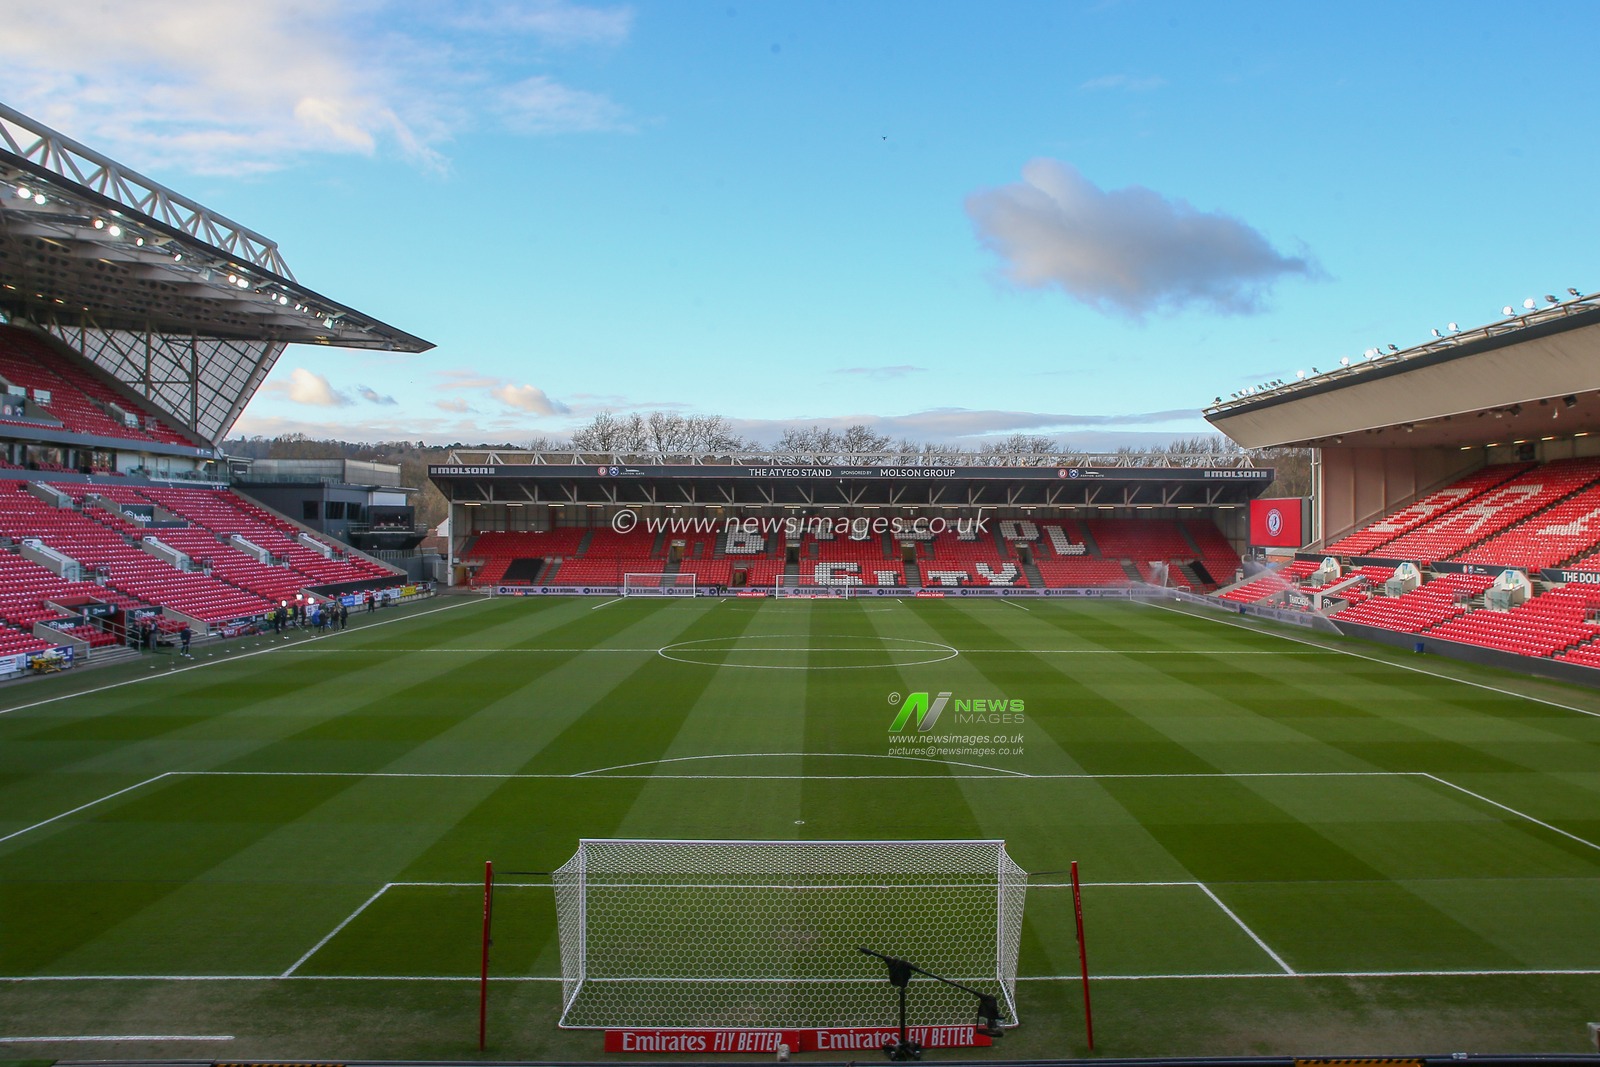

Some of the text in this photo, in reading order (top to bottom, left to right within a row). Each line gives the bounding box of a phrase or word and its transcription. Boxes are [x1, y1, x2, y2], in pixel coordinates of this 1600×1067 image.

[749, 468, 767, 477] THE
[768, 468, 800, 477] ATYEO
[801, 468, 832, 477] STAND
[880, 468, 921, 477] MOLSON
[923, 468, 956, 477] GROUP
[1562, 571, 1578, 582] THE
[622, 1031, 783, 1052] Emirates FLY BETTER
[816, 1026, 974, 1050] Emirates FLY BETTER
